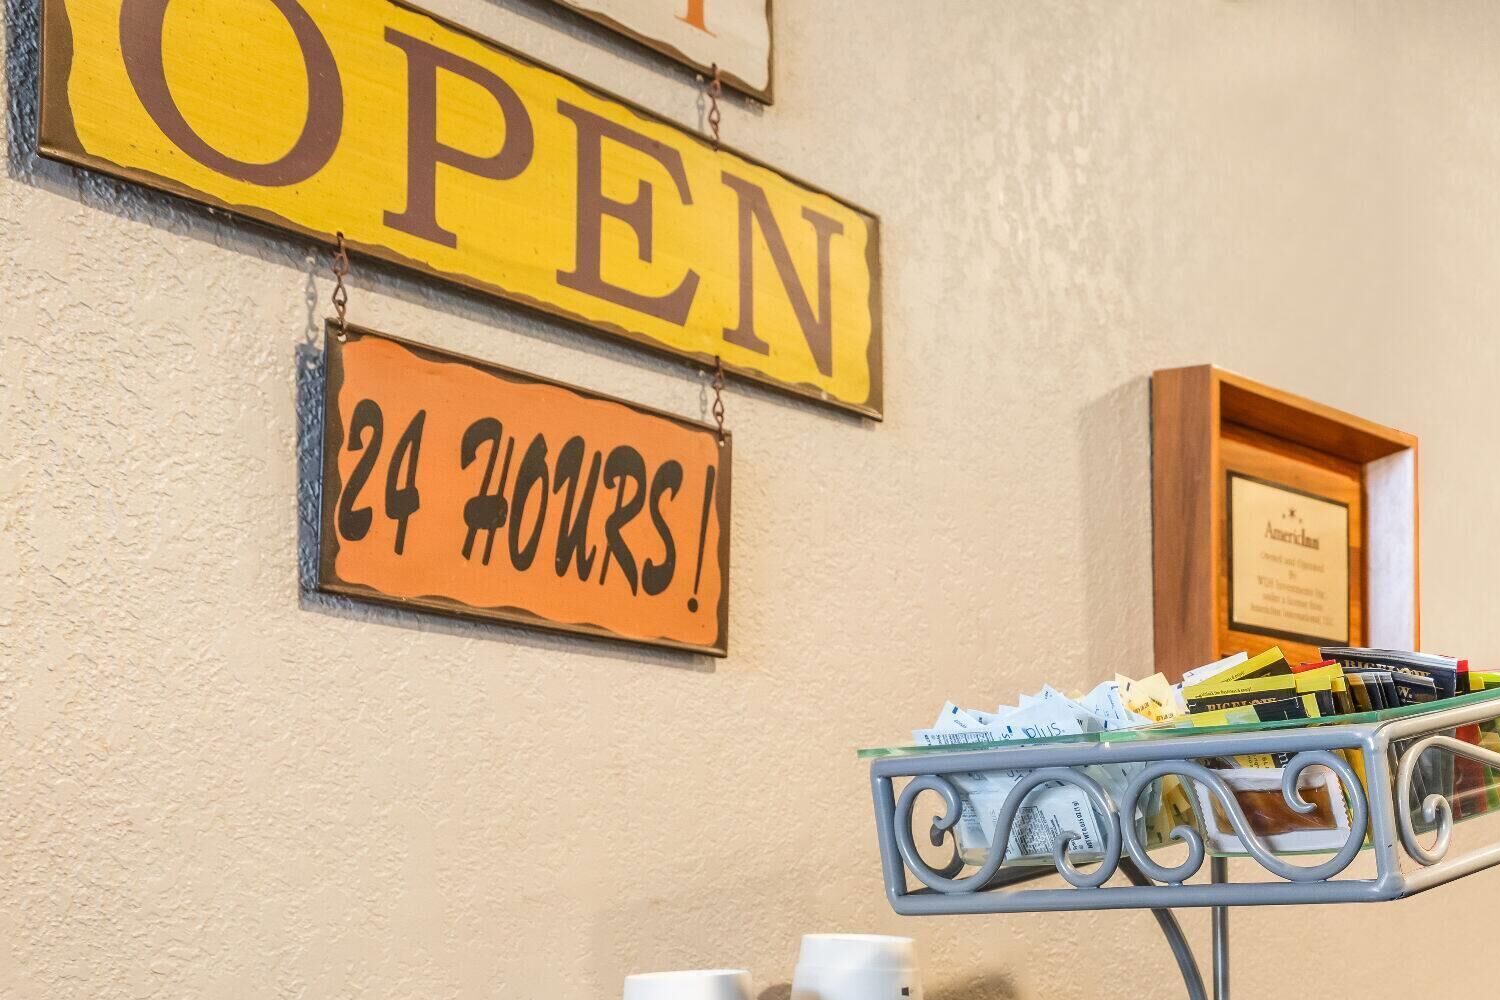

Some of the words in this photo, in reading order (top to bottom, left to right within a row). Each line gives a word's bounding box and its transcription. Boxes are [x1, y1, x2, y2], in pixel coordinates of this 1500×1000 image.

[118, 0, 844, 378] OPEN
[337, 399, 426, 556] 24
[460, 417, 718, 613] HOURS!
